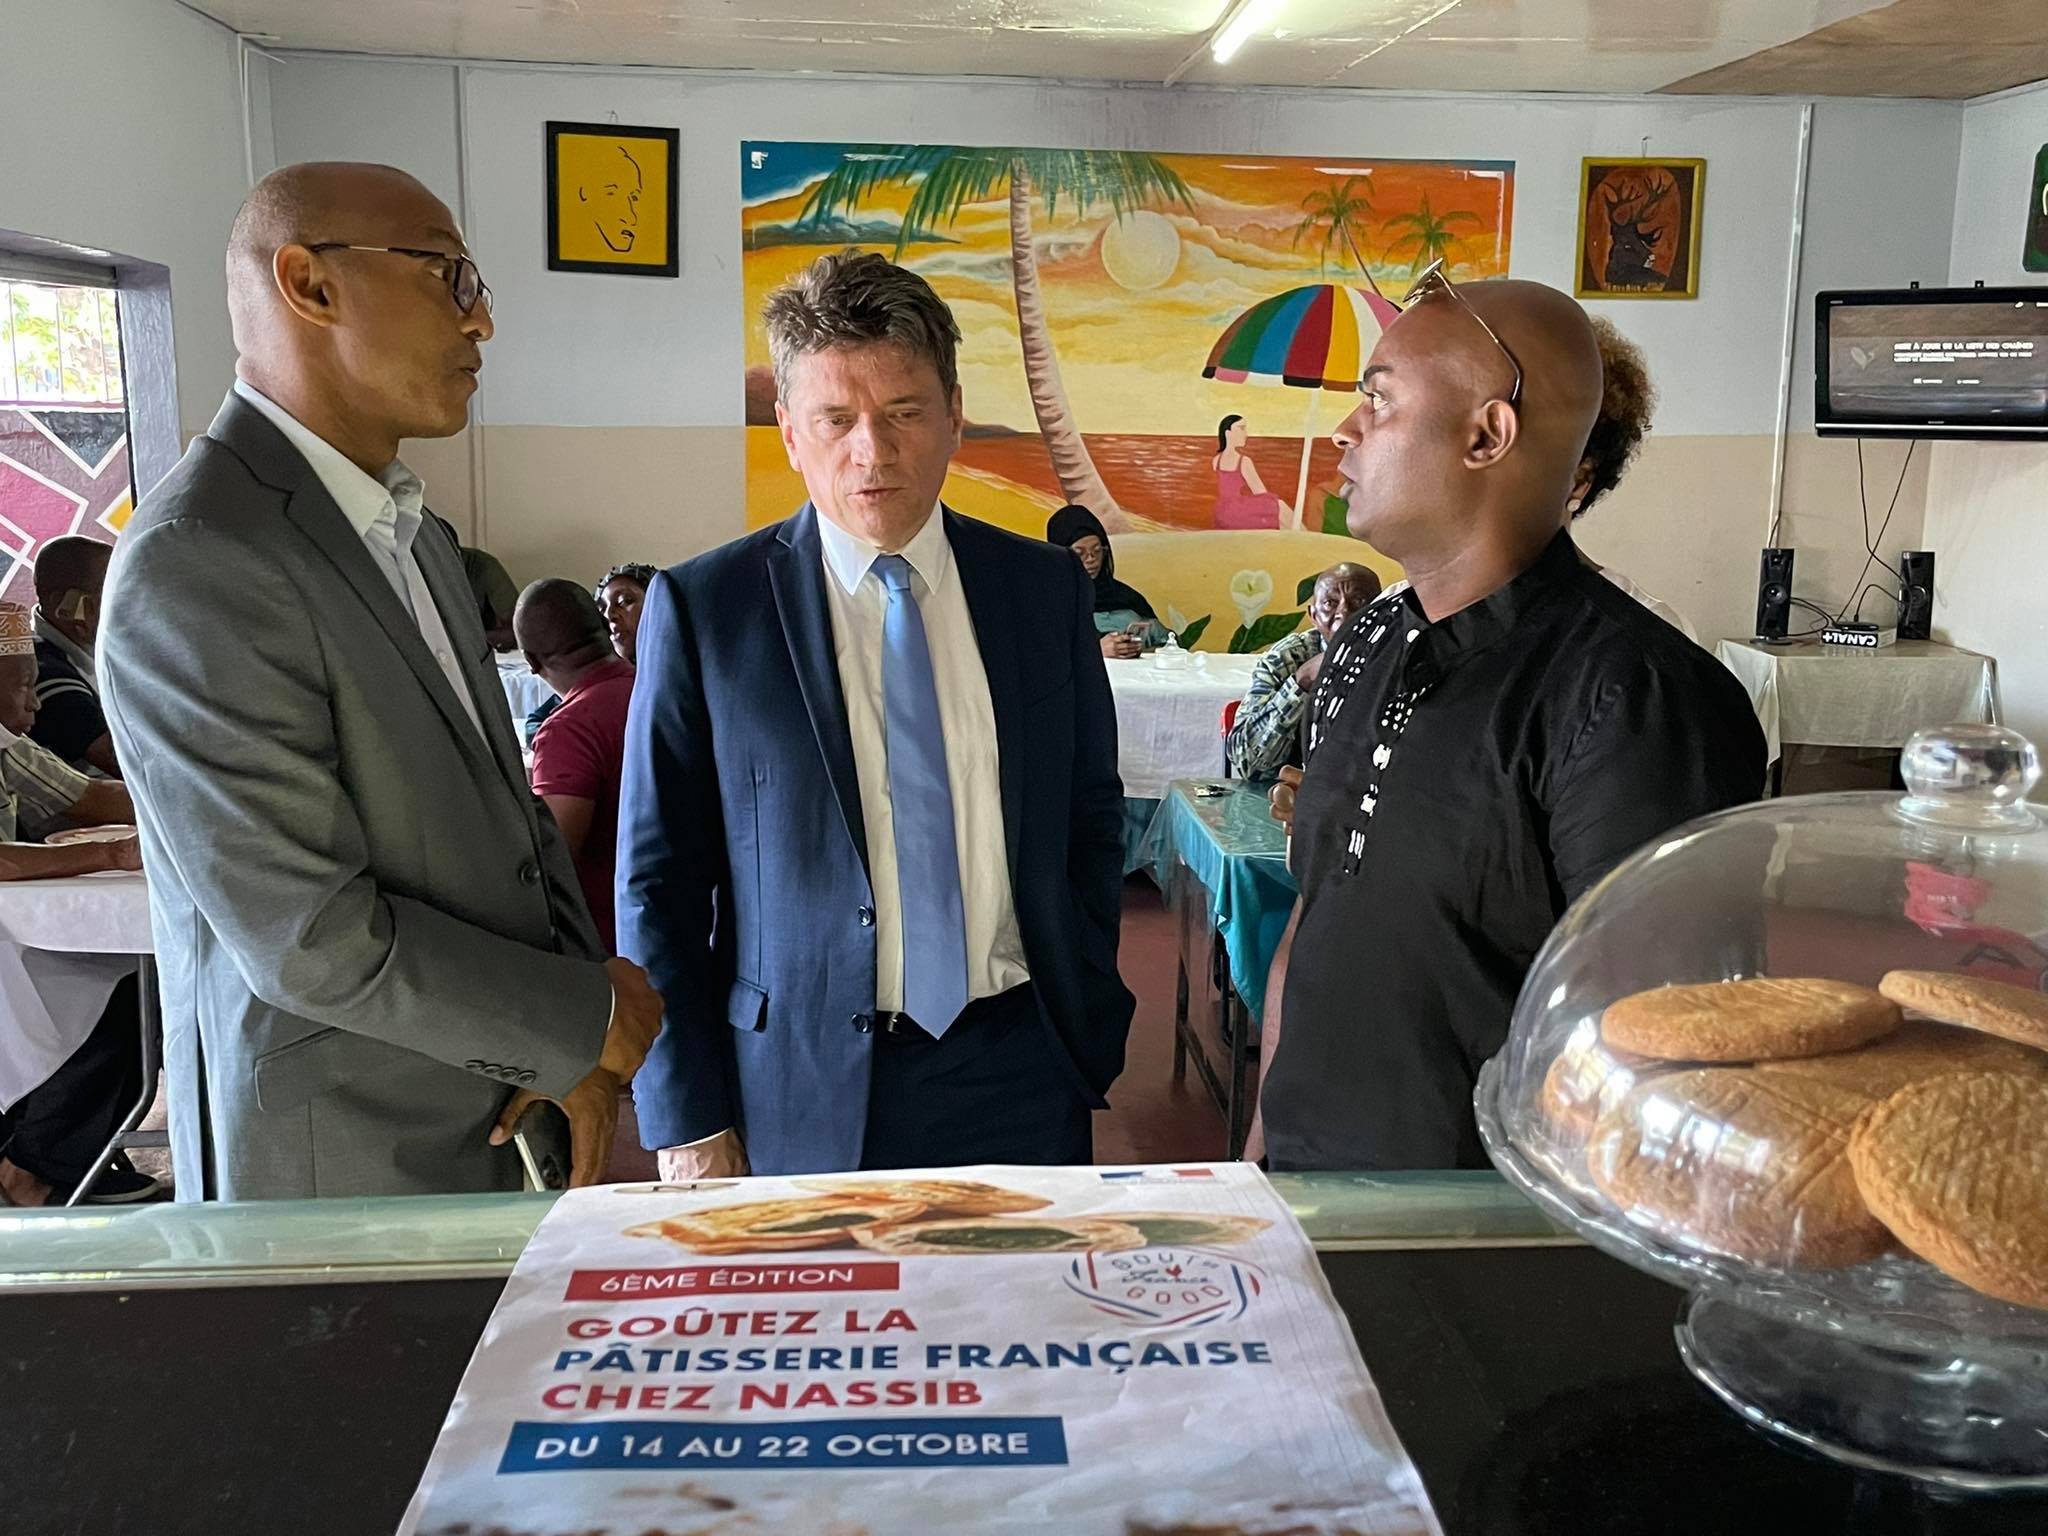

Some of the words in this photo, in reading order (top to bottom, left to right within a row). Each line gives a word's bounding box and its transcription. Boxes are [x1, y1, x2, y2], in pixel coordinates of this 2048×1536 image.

[1823, 632, 1876, 646] CANAL+
[600, 1272, 697, 1293] 6ÈME
[708, 1267, 854, 1288] ÉDITION
[1127, 1285, 1223, 1305] GOOD
[567, 1306, 820, 1339] GOÛTEZ
[844, 1309, 918, 1334] LA
[552, 1342, 899, 1373] PÂTISSERIE
[926, 1341, 1273, 1374] FRANÇAISE
[541, 1384, 715, 1411] CHEZ
[738, 1380, 983, 1411] NASSIB
[534, 1436, 599, 1459] DU
[621, 1436, 664, 1458] 14
[677, 1436, 742, 1458] AU
[757, 1435, 809, 1458] 22
[826, 1432, 1030, 1457] OCTOBRE
